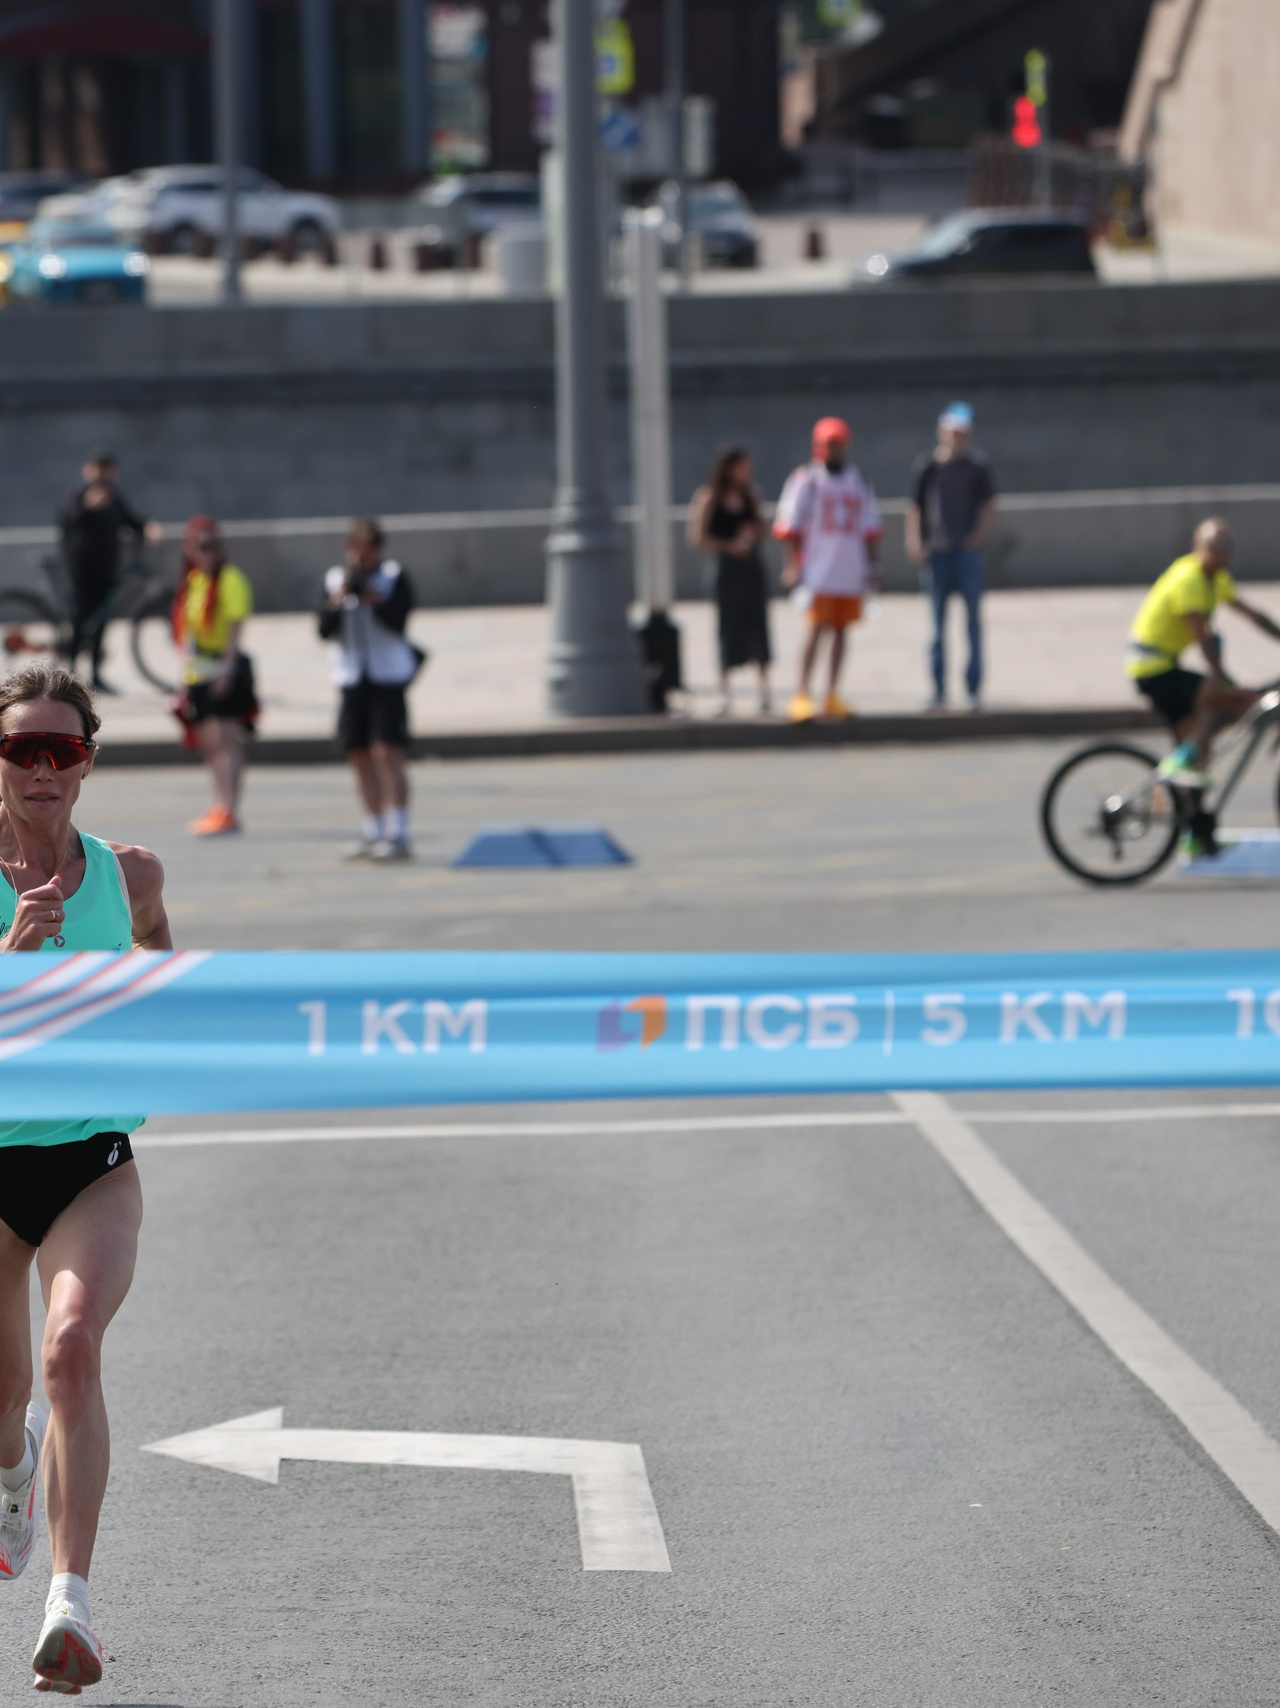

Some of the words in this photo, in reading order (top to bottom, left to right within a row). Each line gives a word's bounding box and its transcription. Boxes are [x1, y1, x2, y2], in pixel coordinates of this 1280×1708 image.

[297, 998, 327, 1057] 1
[360, 998, 490, 1055] КМ
[683, 994, 861, 1052] ПСБ
[920, 993, 968, 1047] 5
[999, 989, 1129, 1045] КМ
